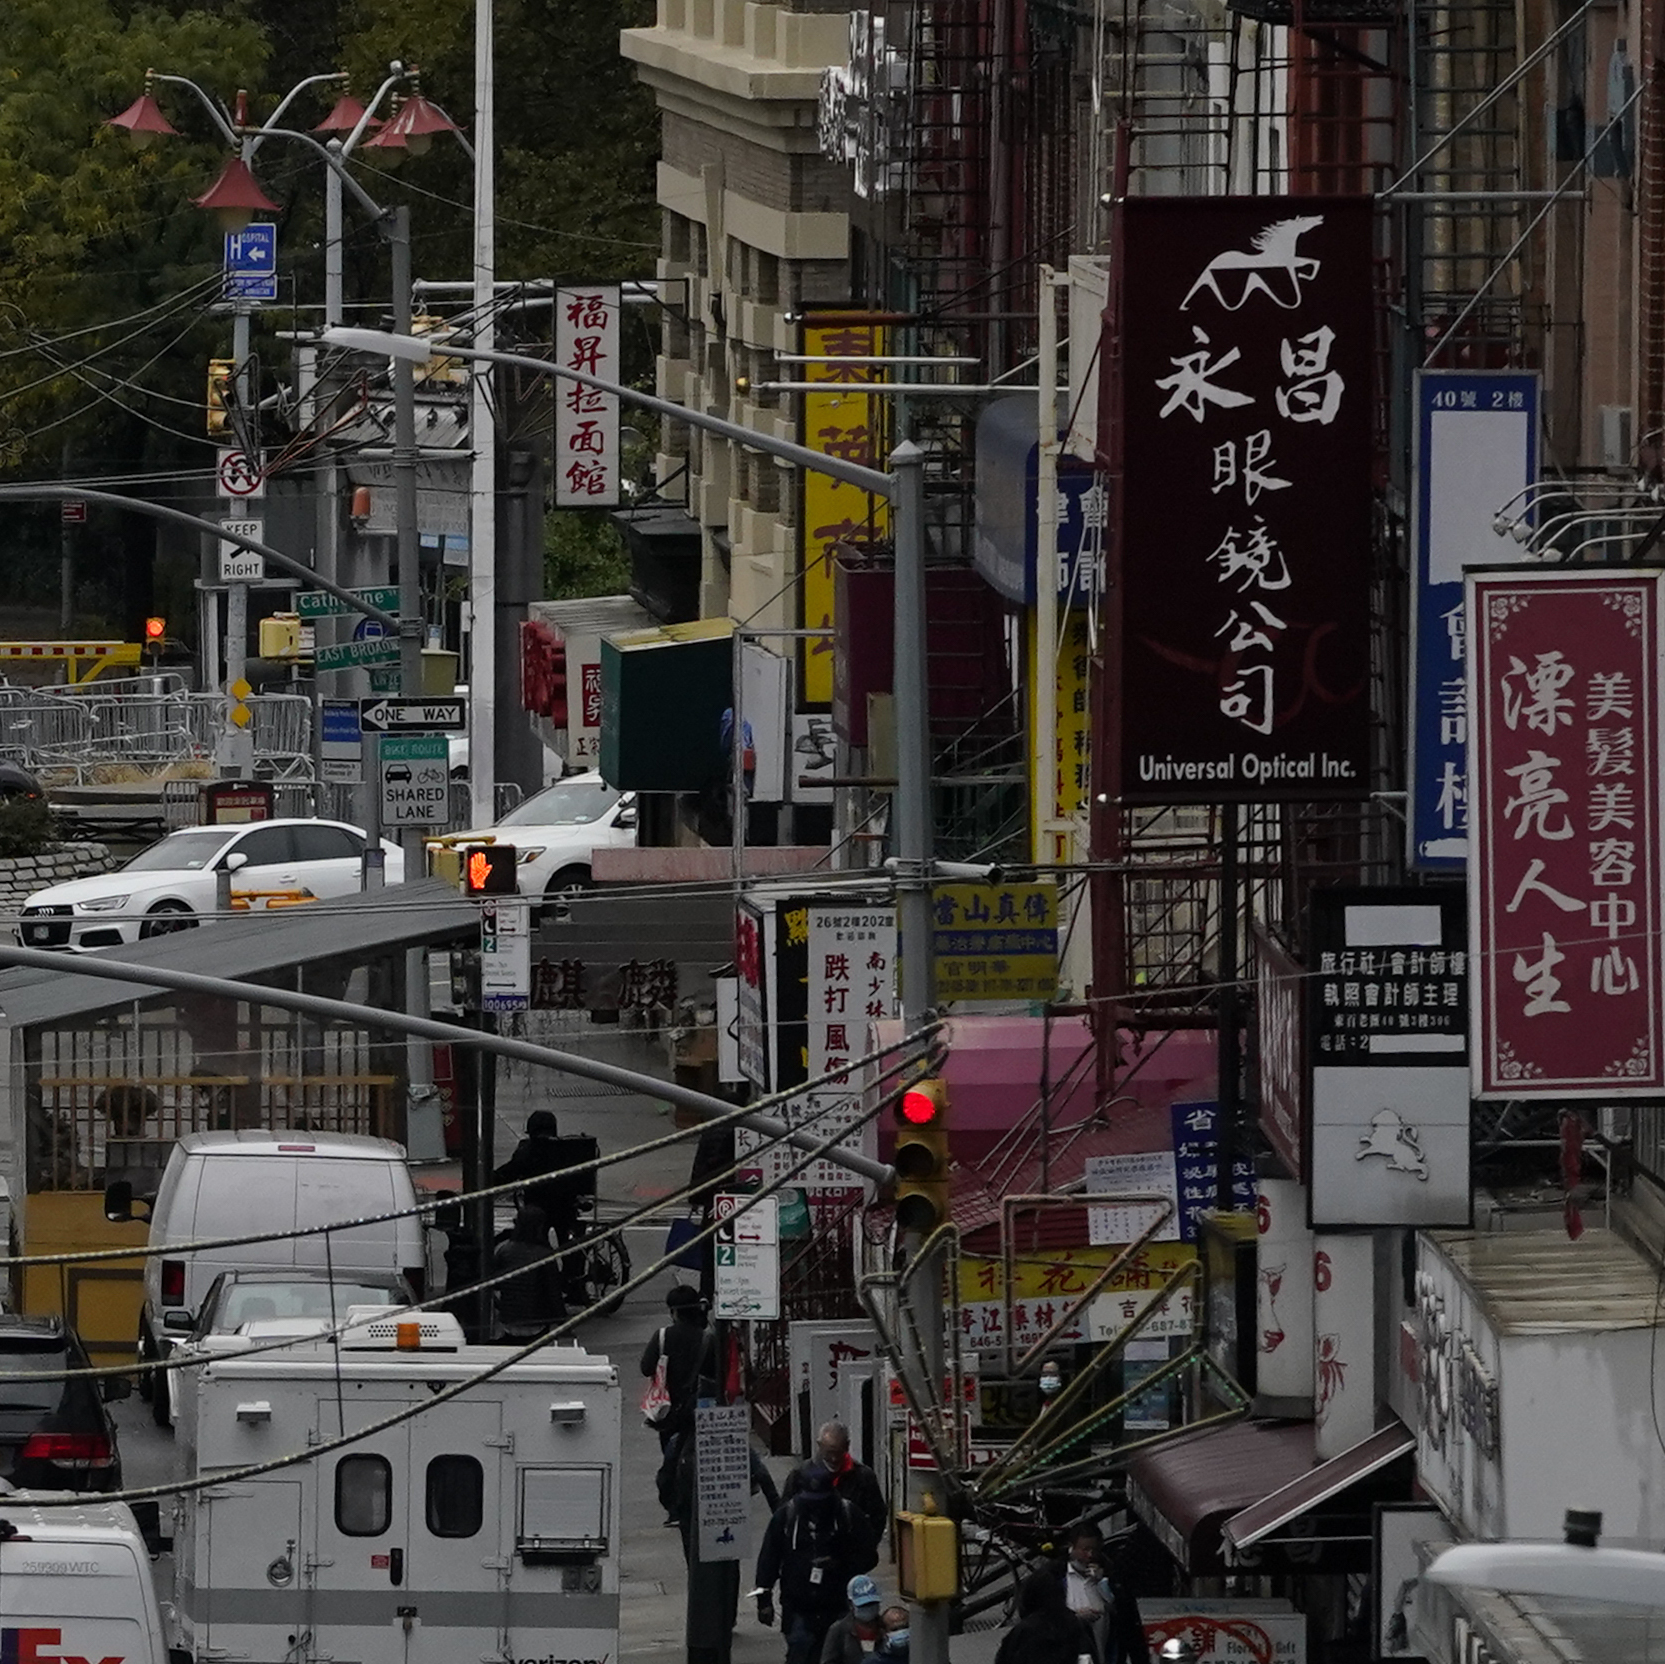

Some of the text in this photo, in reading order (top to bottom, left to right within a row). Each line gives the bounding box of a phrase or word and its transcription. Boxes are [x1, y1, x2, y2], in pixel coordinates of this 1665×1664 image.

[1154, 324, 1346, 426] 永昌
[226, 524, 258, 536] KEEP
[224, 564, 260, 577] RIGHT
[1206, 428, 1293, 736] 眼鏡公司
[317, 647, 347, 662] EAST
[374, 707, 457, 721] ONE WAY
[1139, 751, 1358, 785] Universal Optical Inc.
[385, 788, 444, 802] SHARED
[396, 805, 435, 820] LANE
[1501, 650, 1587, 1017] 漂亮人生
[1585, 672, 1640, 996] 美髮美容中心
